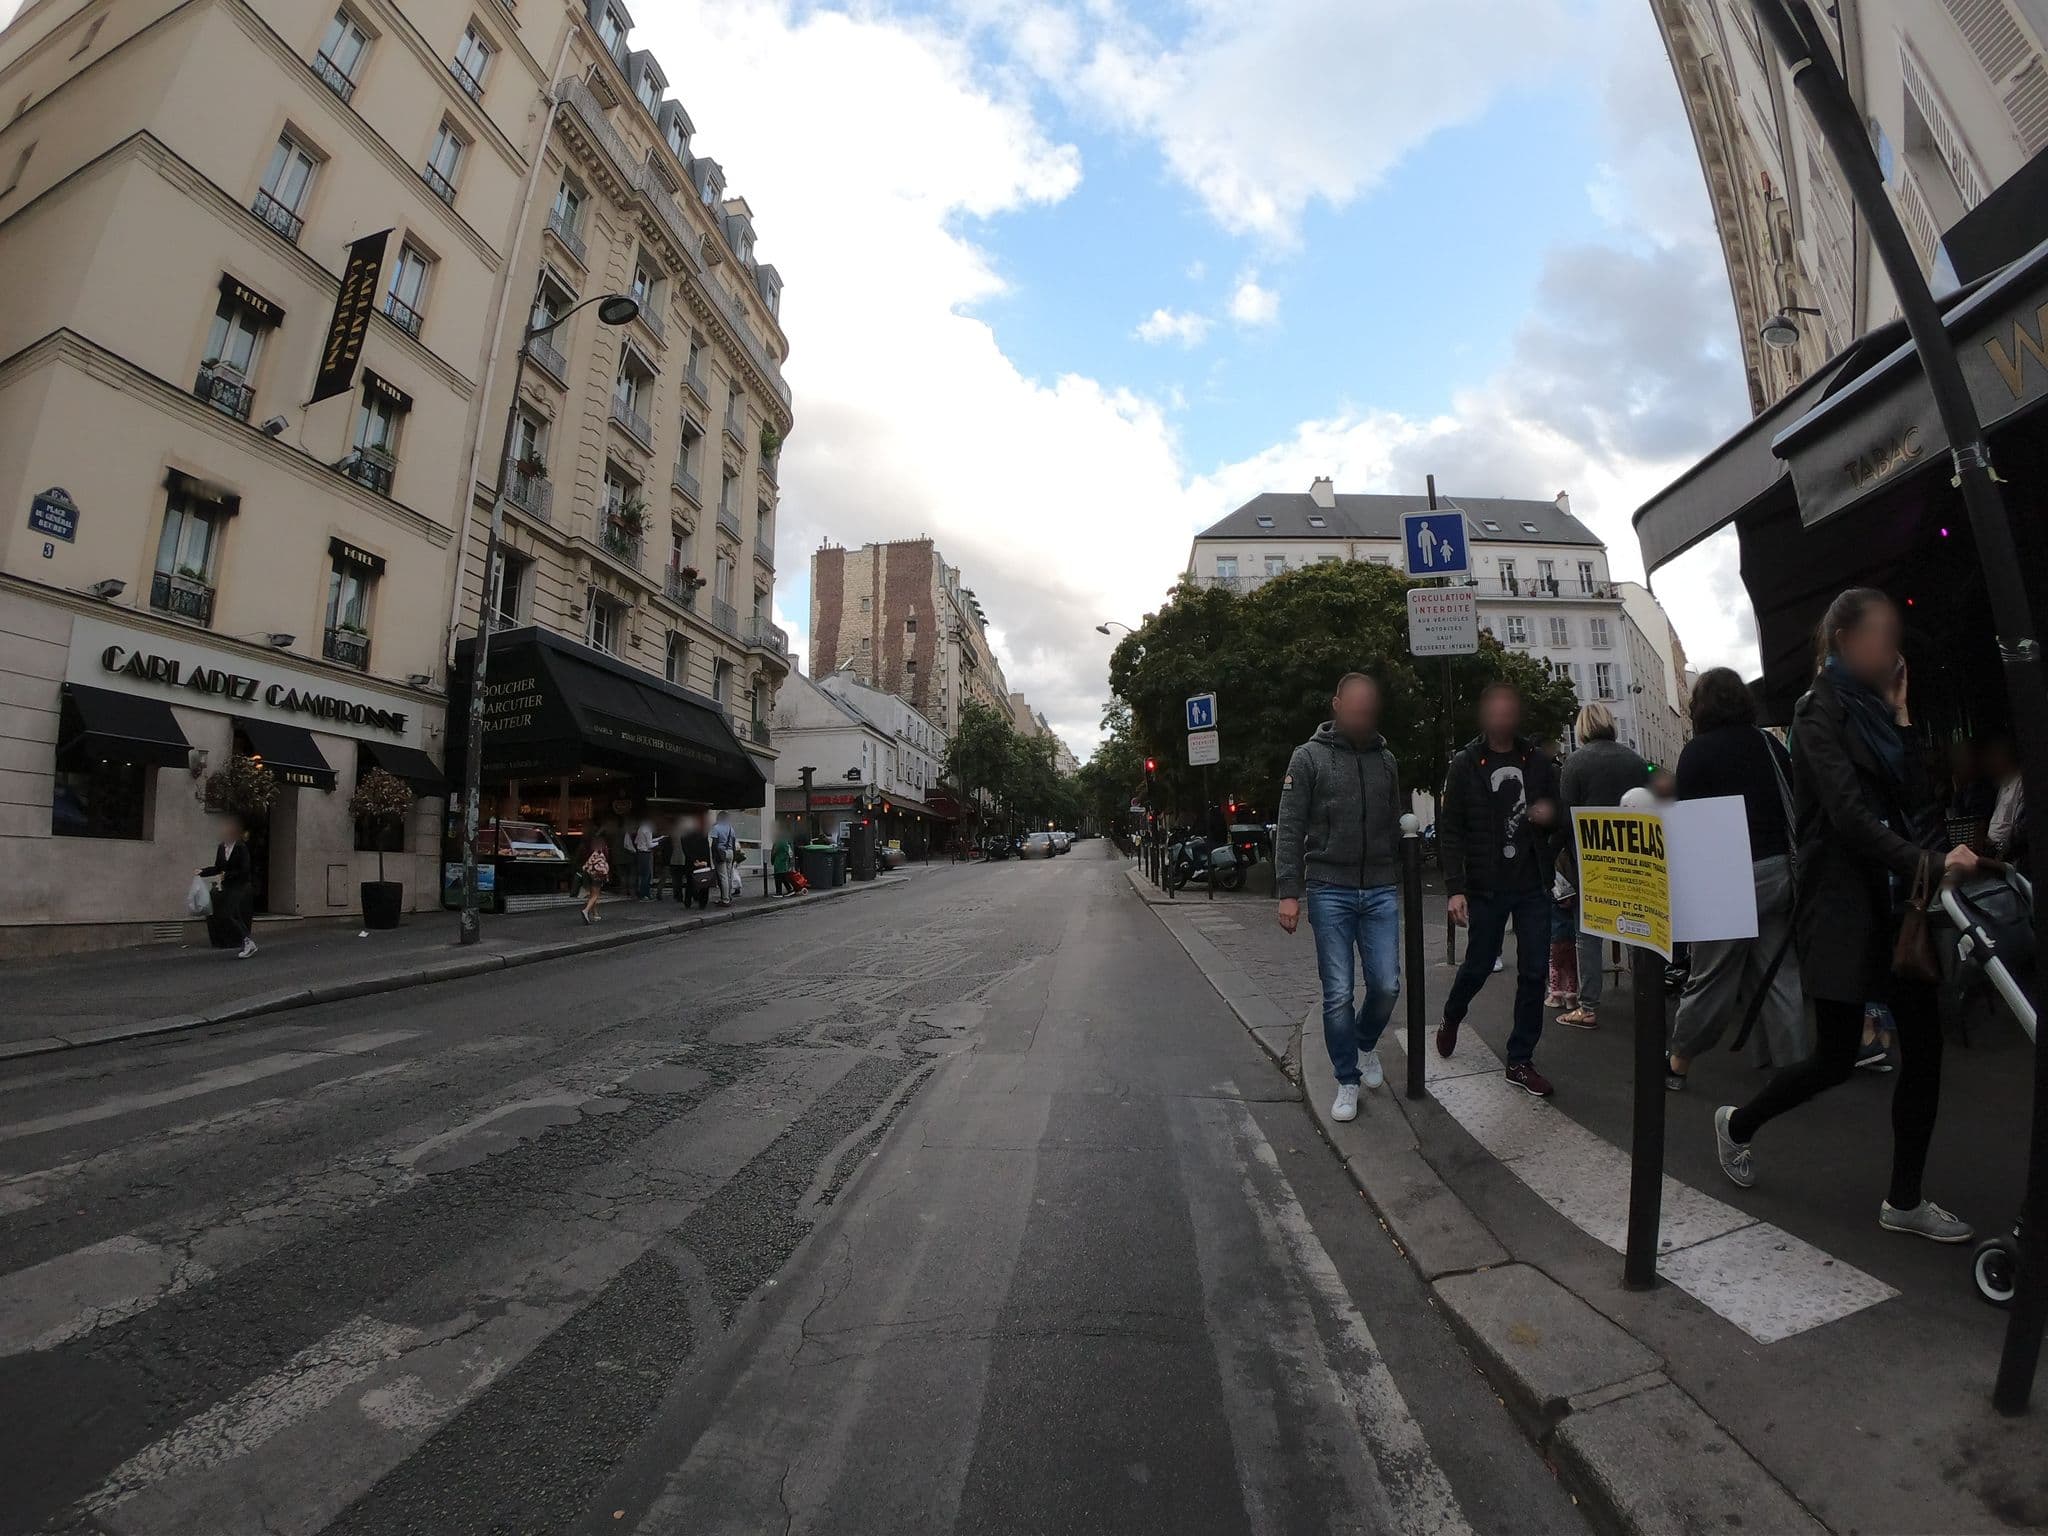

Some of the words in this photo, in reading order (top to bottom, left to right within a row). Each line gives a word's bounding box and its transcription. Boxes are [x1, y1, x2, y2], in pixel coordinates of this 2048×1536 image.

[236, 285, 270, 316] HOTEL
[376, 378, 402, 402] HOTEL
[1844, 425, 1923, 490] TABAC
[44, 543, 53, 557] 3
[344, 545, 374, 567] HOTEL
[1412, 592, 1472, 603] CIRCULATION
[1415, 604, 1470, 615] INTERDITE
[102, 645, 261, 703] CARLADEZ
[265, 684, 409, 735] CAMBRONNE
[1579, 819, 1664, 860] MATELAS
[1582, 853, 1616, 864] LIQUIDATION
[1617, 856, 1638, 867] TOTALE
[1585, 894, 1593, 902] CE
[1594, 896, 1621, 908] SAMEDI
[1622, 901, 1632, 910] ET
[1633, 903, 1643, 912] CE
